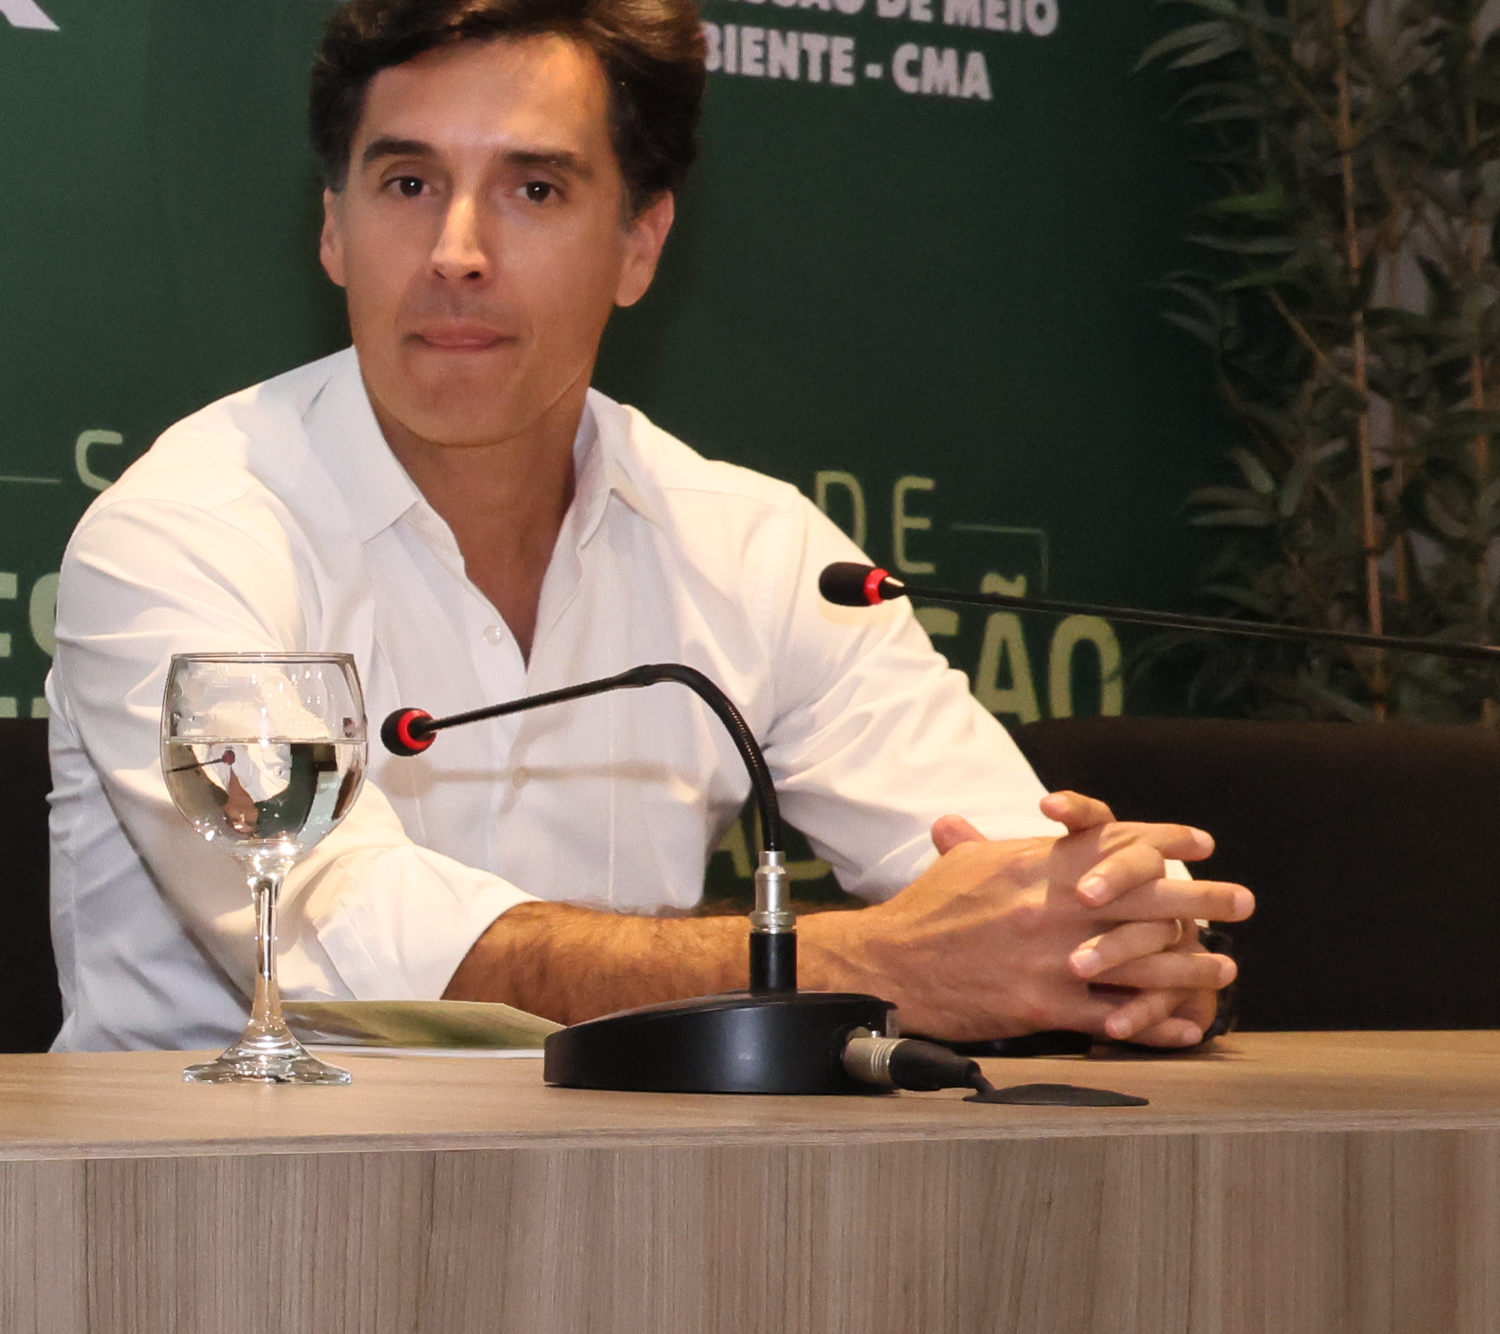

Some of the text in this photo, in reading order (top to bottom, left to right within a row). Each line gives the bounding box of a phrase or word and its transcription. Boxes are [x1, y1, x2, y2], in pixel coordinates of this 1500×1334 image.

[705, 22, 856, 87] BIENTE
[892, 42, 993, 102] CMA
[816, 469, 936, 575] DE
